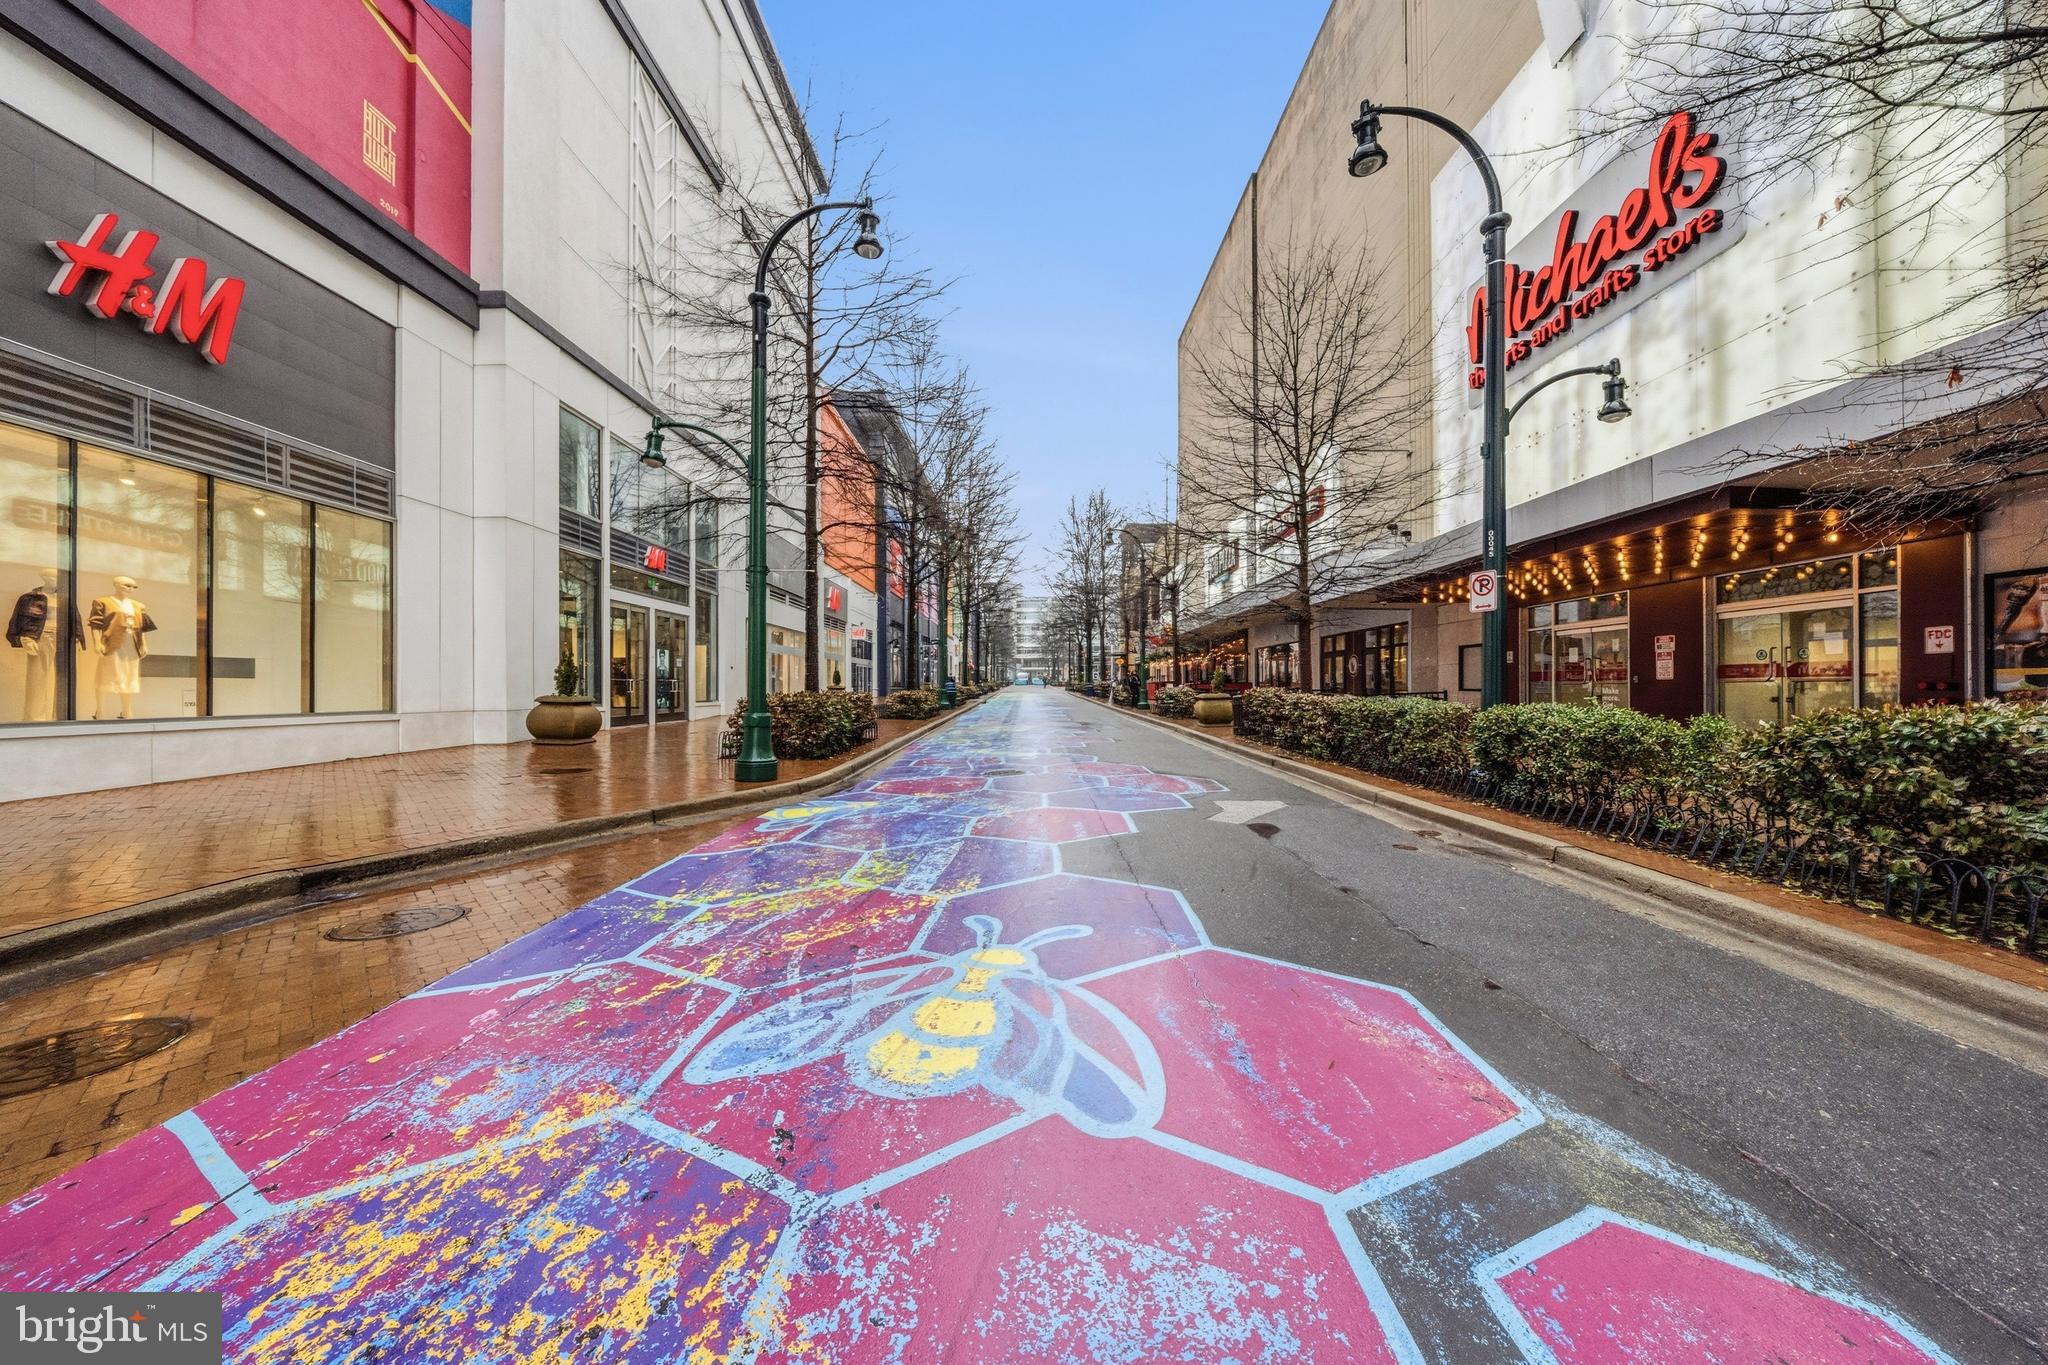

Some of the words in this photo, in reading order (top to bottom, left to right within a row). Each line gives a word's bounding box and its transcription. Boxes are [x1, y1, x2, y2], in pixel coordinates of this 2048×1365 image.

[380, 198, 399, 217] 2019
[44, 213, 246, 365] H&M
[1469, 367, 1485, 389] th
[1505, 340, 1532, 370] rts
[1530, 304, 1571, 350] and
[1571, 264, 1641, 321] crafts
[1643, 208, 1724, 272] store
[1928, 628, 1952, 640] FDC
